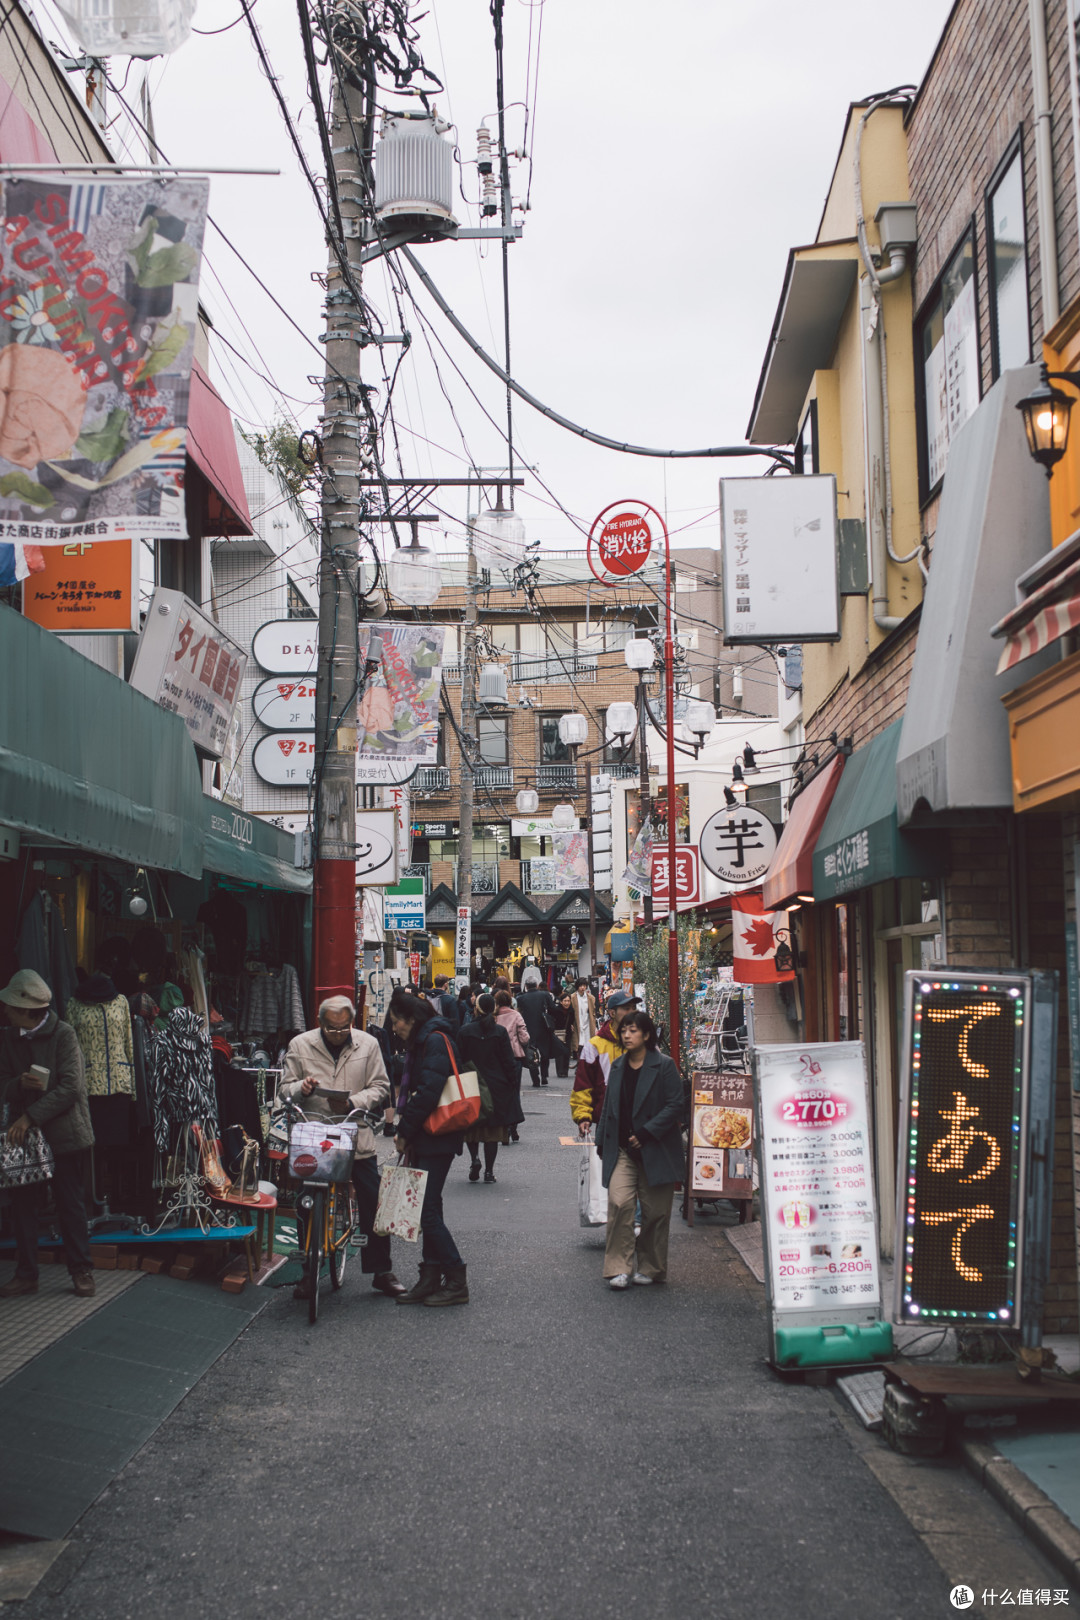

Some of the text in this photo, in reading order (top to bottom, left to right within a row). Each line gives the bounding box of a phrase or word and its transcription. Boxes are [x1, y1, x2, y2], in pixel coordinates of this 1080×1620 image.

[4, 215, 110, 391] AUTUMN
[606, 518, 643, 530] FIRE HYDRANT
[603, 529, 648, 559] 消火栓
[289, 714, 300, 723] 2F
[286, 769, 296, 778] 1F
[714, 819, 765, 868] 芋
[653, 857, 689, 892] 薬
[717, 864, 766, 879] Robson Fries
[385, 901, 422, 909] FamilyMart
[401, 920, 420, 928] たばこ
[700, 1078, 748, 1089] フライドポテト
[720, 1090, 745, 1100] 専門店
[921, 1002, 1001, 1281] てあて
[793, 1291, 804, 1301] 2F
